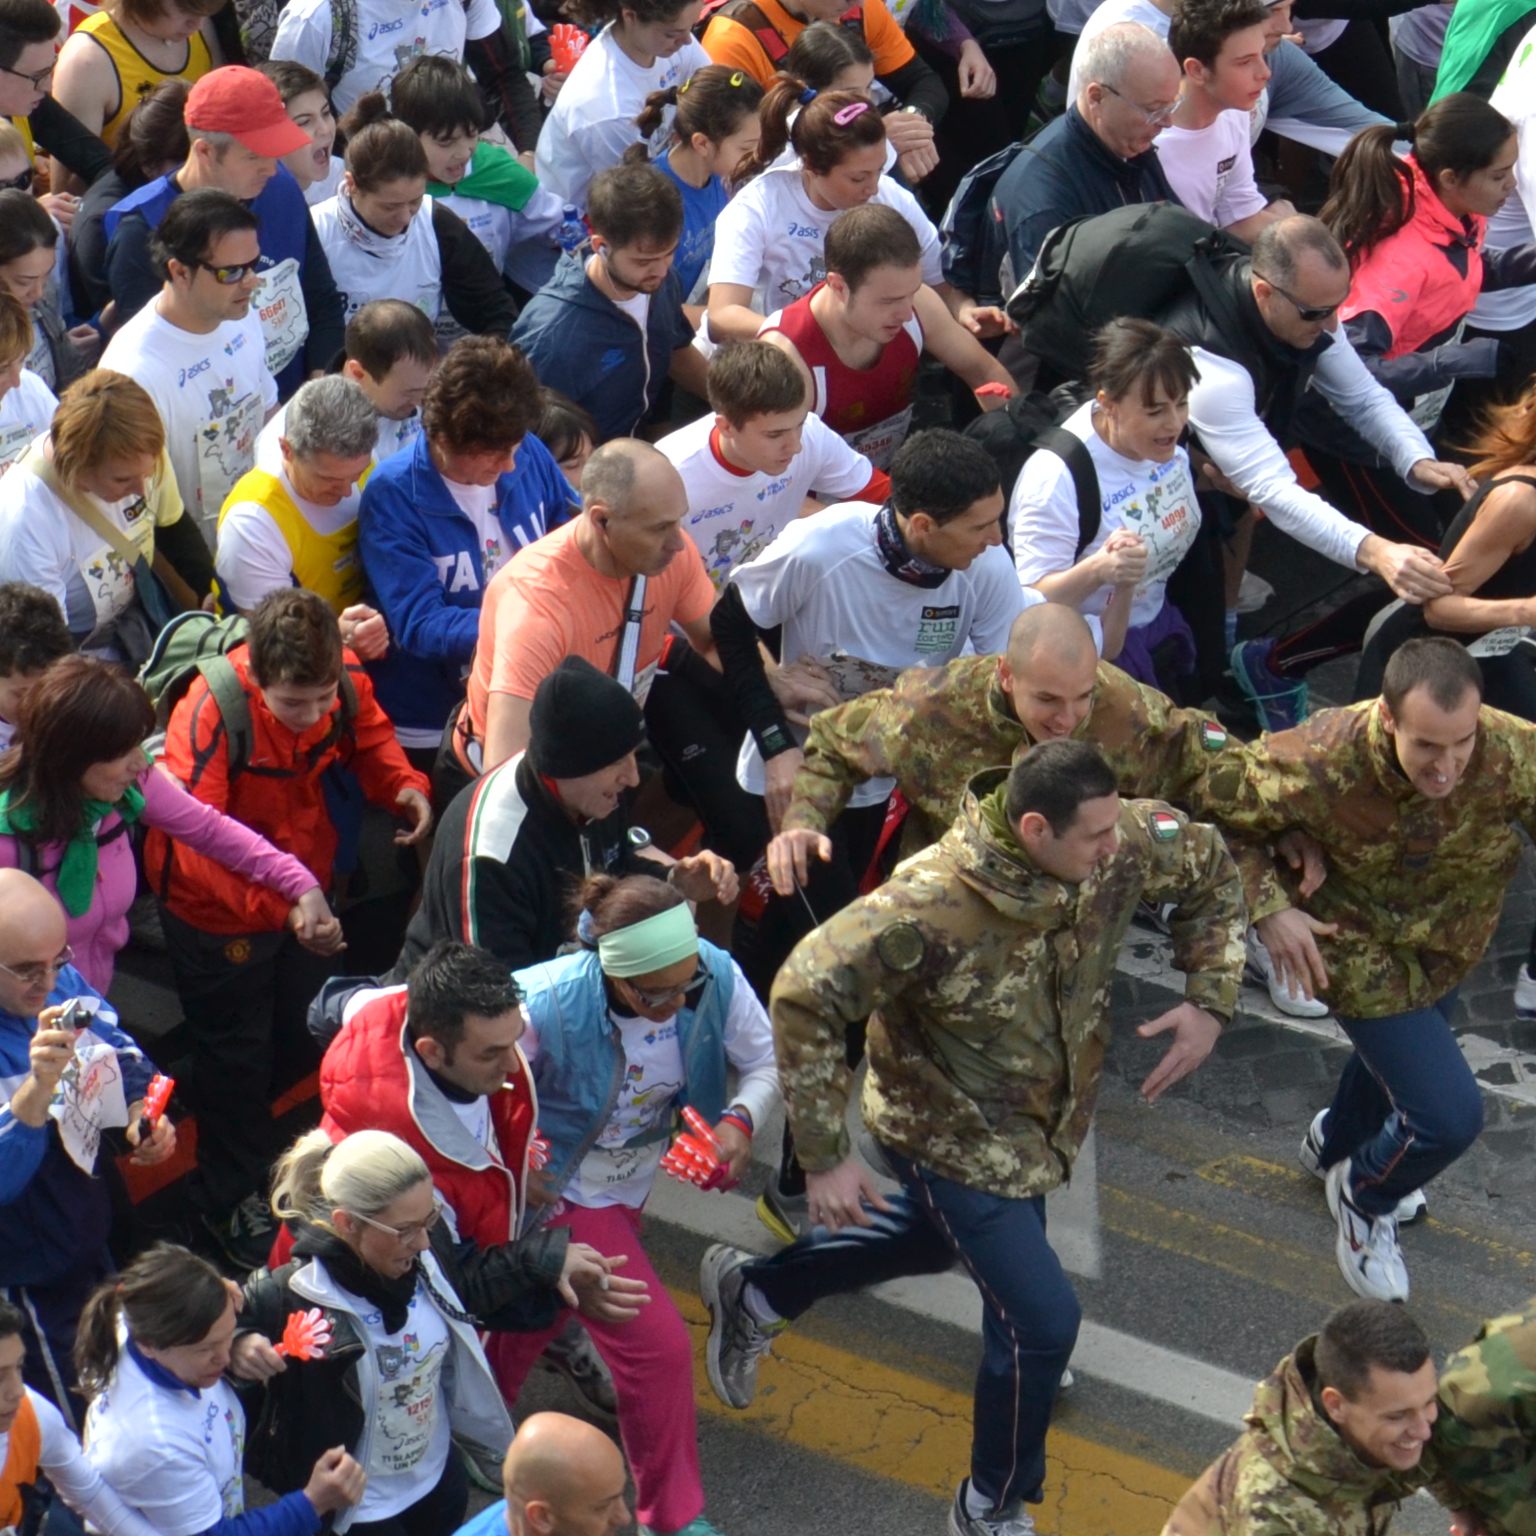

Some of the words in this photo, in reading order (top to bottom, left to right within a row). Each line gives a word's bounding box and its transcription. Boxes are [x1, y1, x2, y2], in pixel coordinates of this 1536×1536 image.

[380, 19, 404, 35] asics
[187, 357, 209, 375] asics
[1109, 485, 1135, 505] asics
[704, 503, 733, 519] asics
